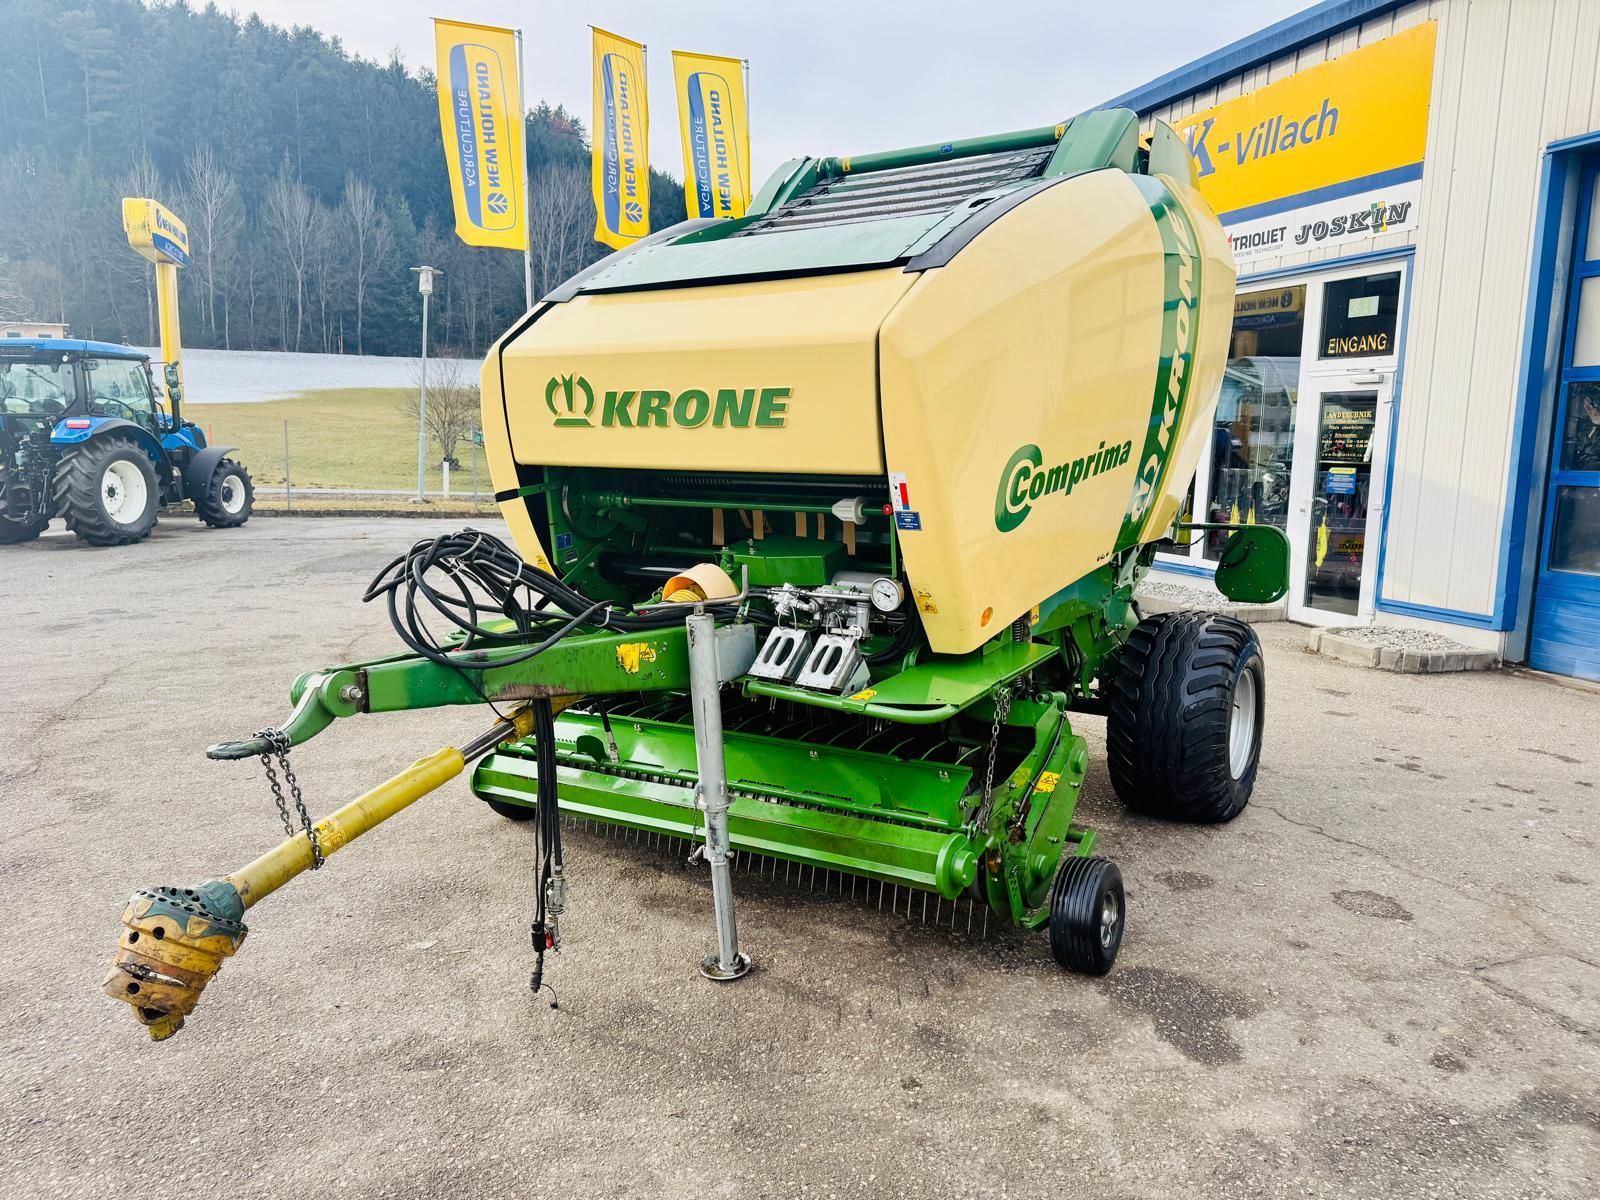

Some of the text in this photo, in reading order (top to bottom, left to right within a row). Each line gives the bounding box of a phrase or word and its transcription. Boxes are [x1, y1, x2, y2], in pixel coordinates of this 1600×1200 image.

[1233, 226, 1287, 251] TRIOLIET
[1294, 200, 1412, 245] JOSKIN
[1327, 333, 1389, 355] EINGANG
[601, 386, 793, 429] KRONE
[1324, 410, 1372, 420] LANDTECHNIK
[1010, 439, 1133, 508] Comprima
